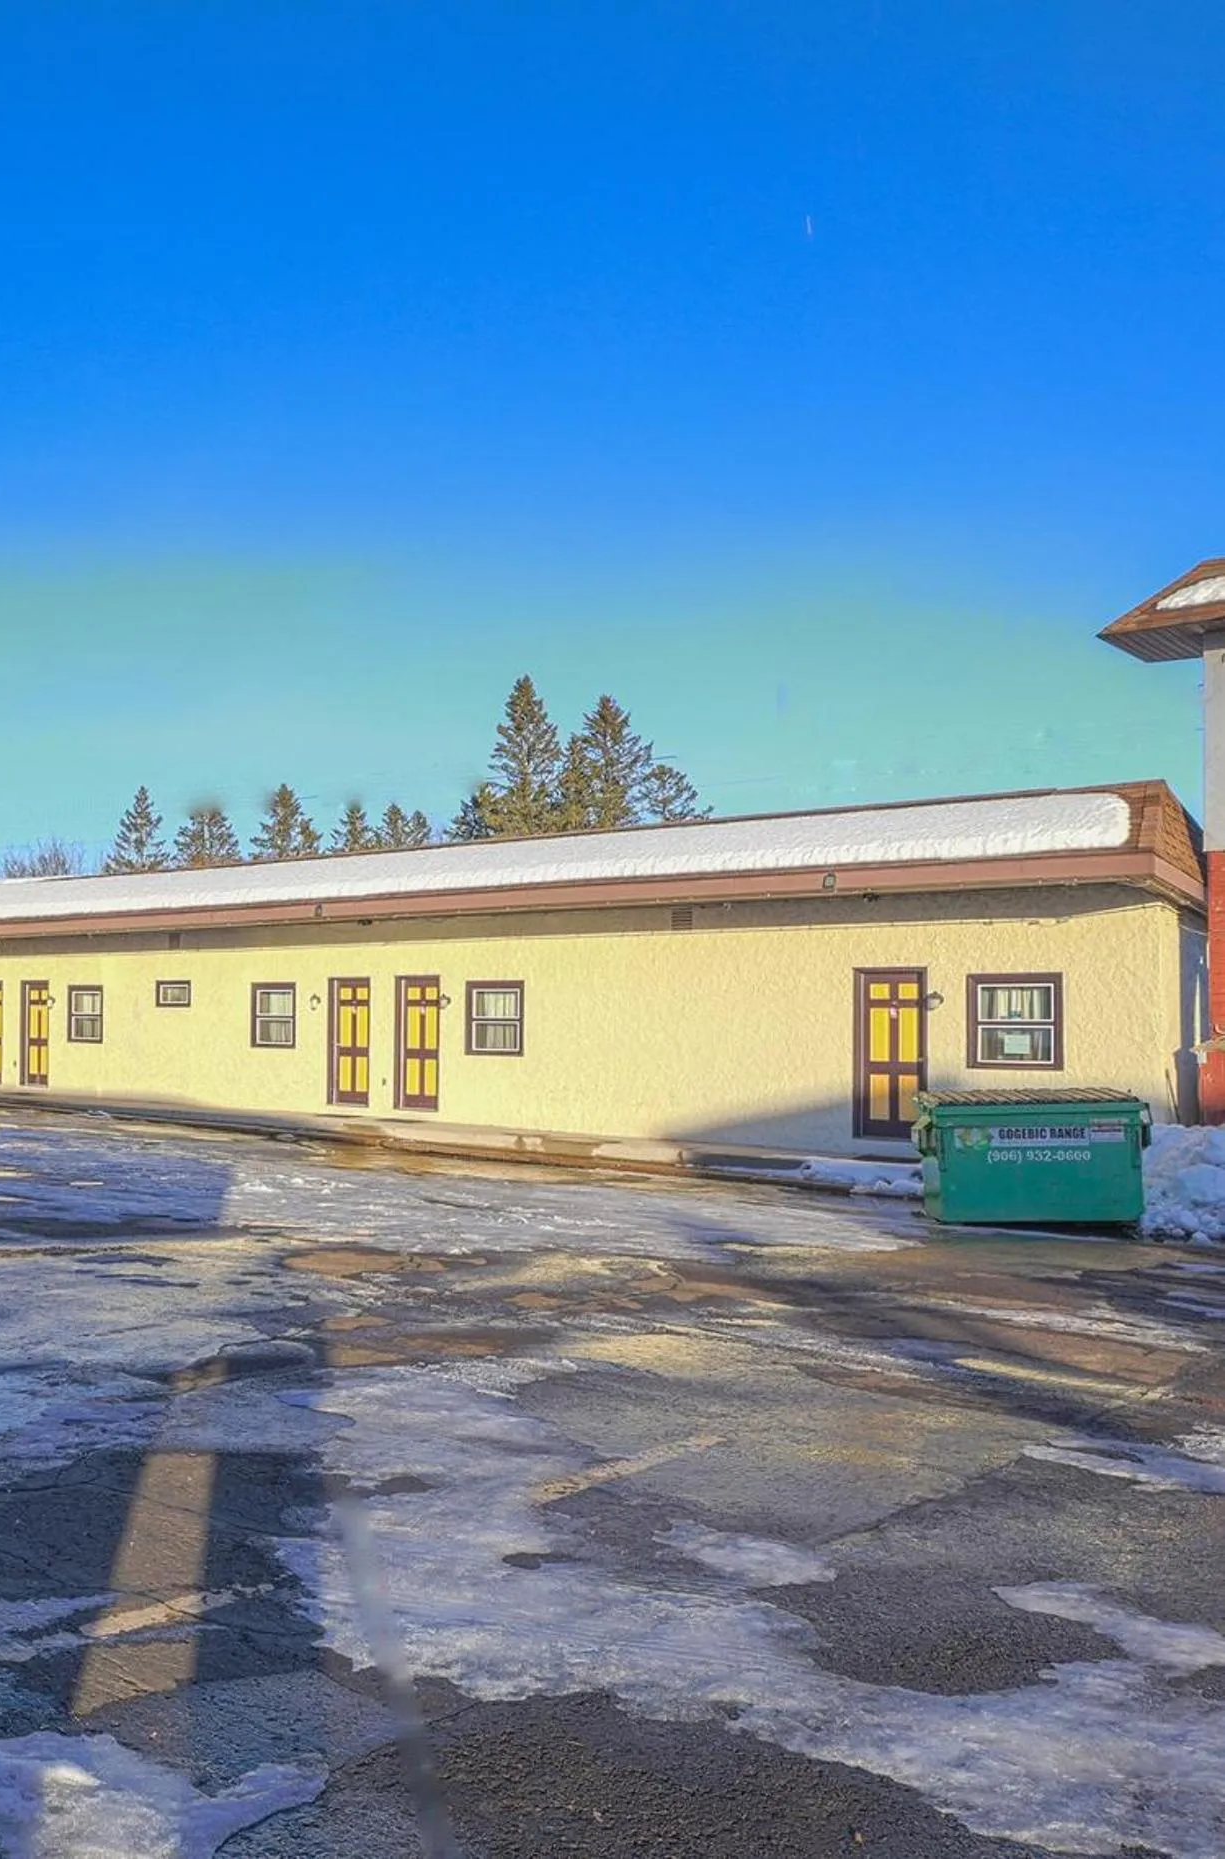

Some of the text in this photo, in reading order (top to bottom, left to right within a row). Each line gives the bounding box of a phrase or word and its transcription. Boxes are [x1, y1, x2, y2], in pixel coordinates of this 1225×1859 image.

[998, 1127, 1086, 1140] GOGEBIC RANGE
[987, 1150, 1022, 1164] (906)
